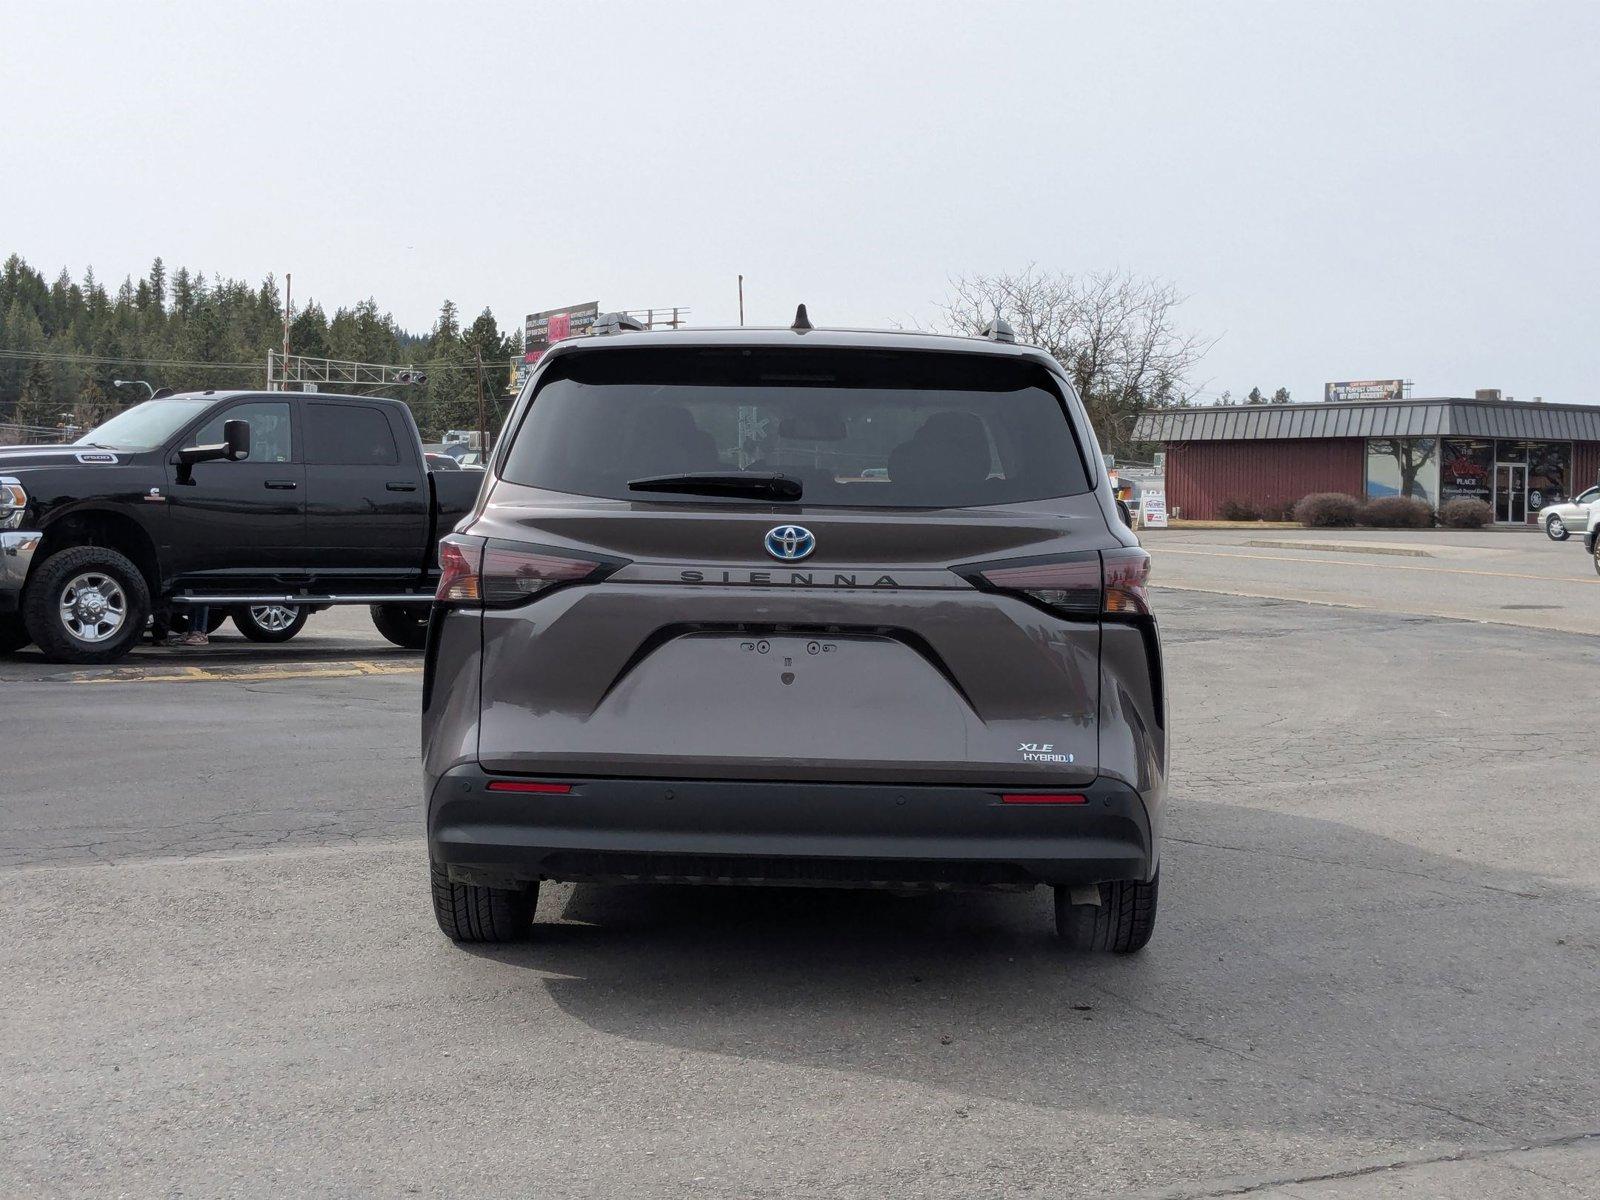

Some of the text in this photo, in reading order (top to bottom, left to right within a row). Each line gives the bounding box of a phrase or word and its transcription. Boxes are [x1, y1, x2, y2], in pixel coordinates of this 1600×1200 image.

[680, 570, 899, 587] SIENNA
[1017, 743, 1054, 752] XLE
[1023, 753, 1066, 763] HYBRID
